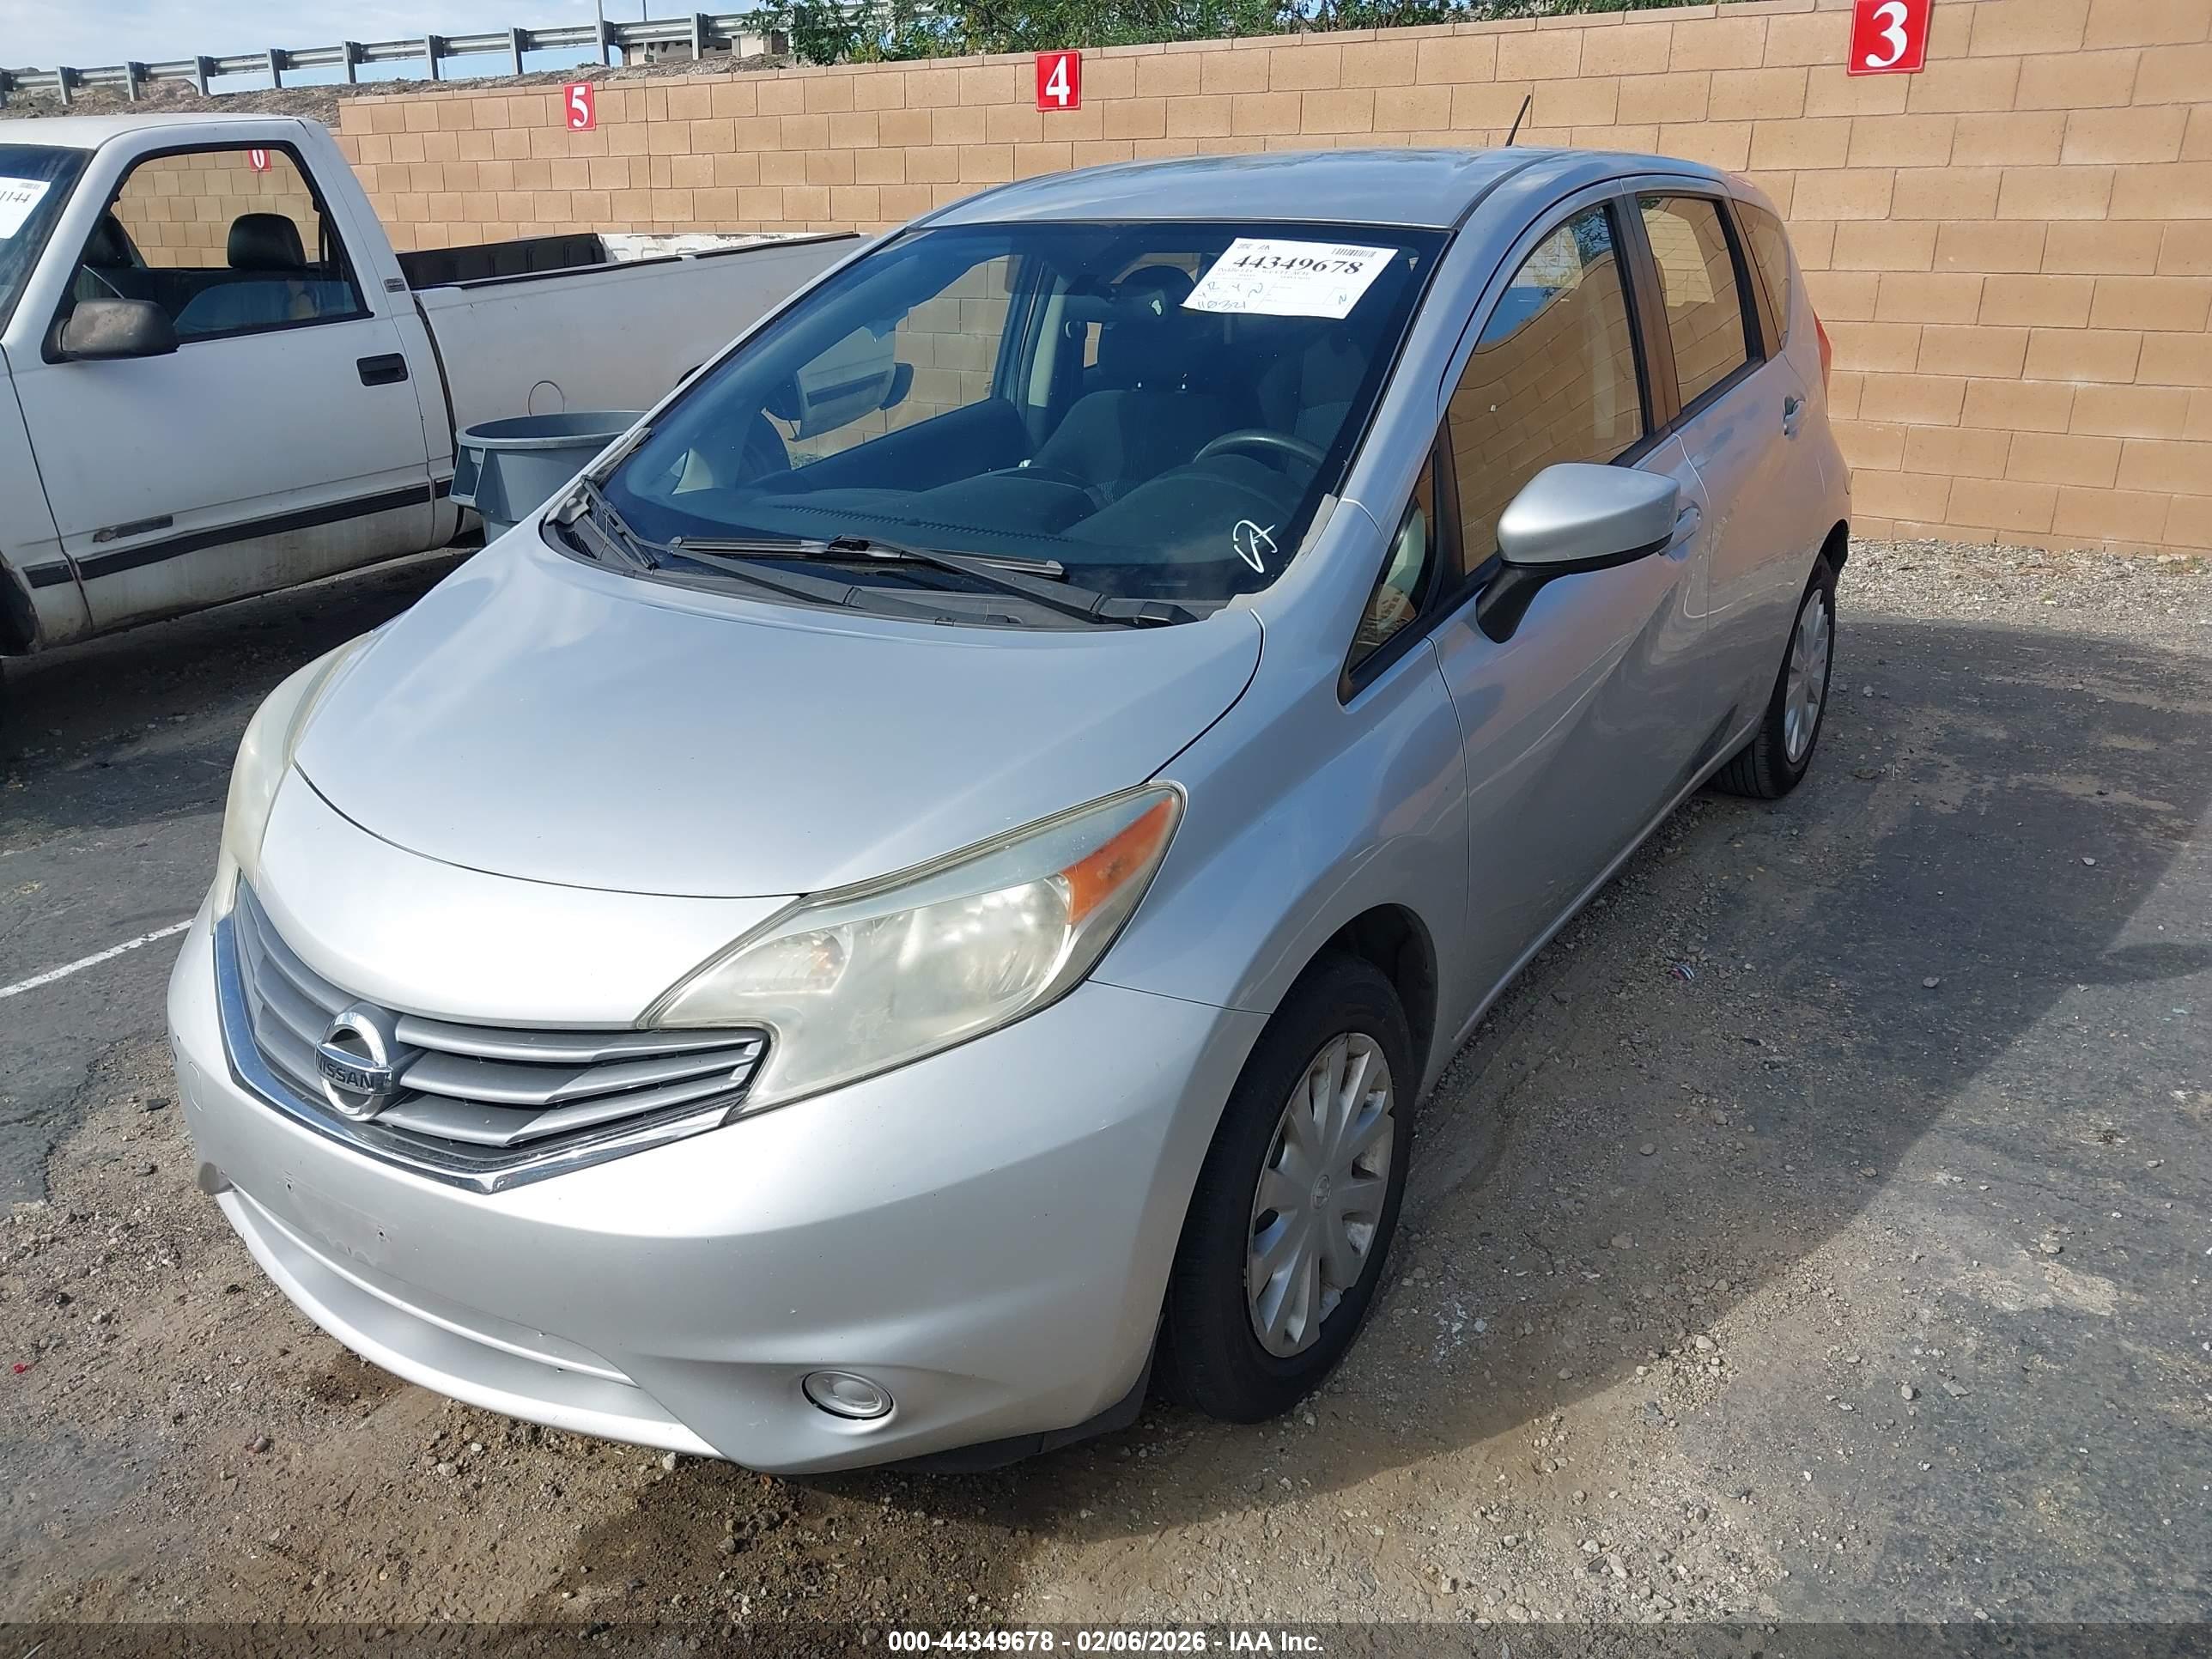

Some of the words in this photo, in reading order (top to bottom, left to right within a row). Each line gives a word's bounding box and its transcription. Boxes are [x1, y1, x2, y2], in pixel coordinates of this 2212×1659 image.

[1865, 1, 1908, 68] 3
[1045, 55, 1071, 106] 4
[571, 86, 589, 128] 5
[1232, 254, 1364, 275] 44349678
[315, 1053, 374, 1089] NISSAN
